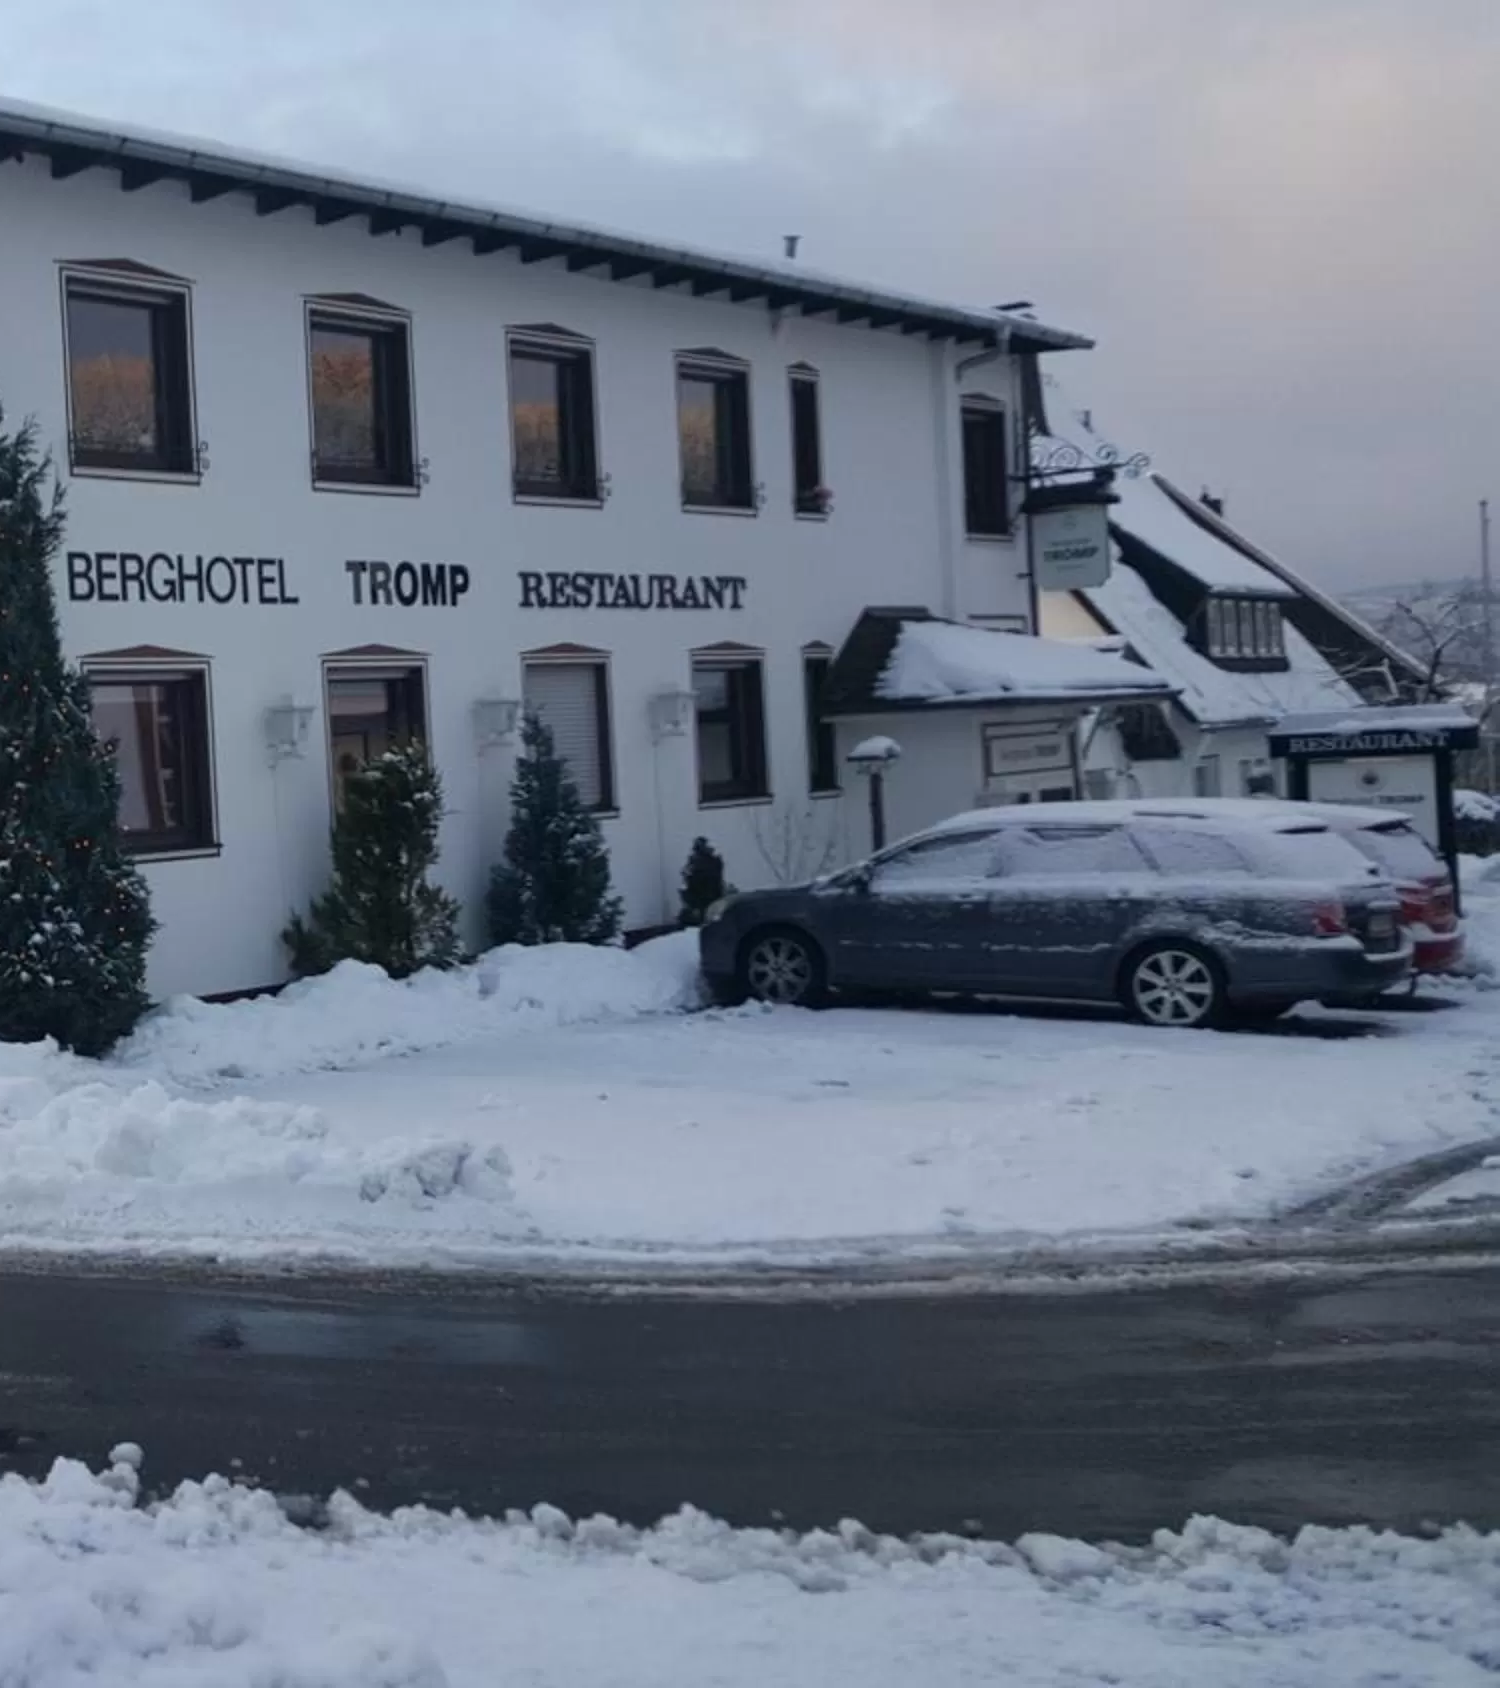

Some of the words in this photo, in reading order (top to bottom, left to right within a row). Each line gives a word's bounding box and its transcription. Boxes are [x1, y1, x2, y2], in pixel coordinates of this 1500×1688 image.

[66, 551, 299, 605] BERGHOTEL
[345, 560, 471, 607] TROMP
[517, 571, 748, 609] RESTAURANT
[1289, 732, 1449, 753] RESTAURANT
